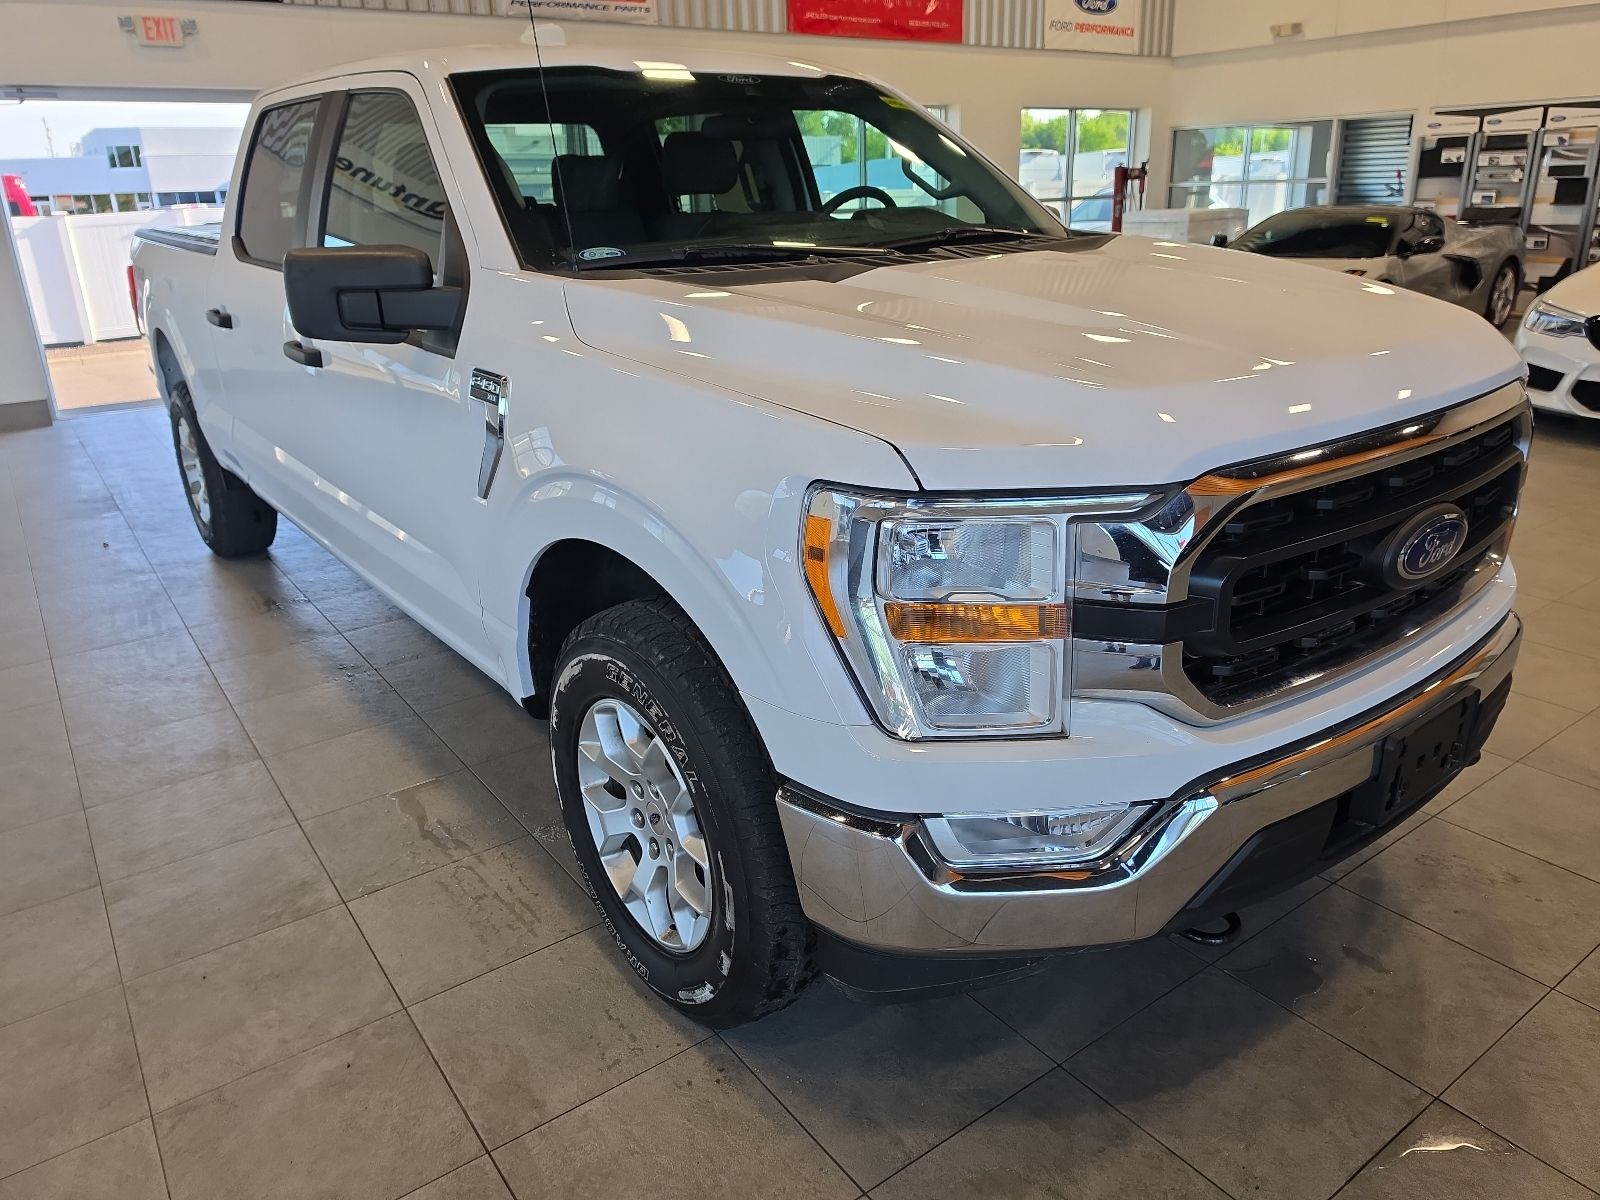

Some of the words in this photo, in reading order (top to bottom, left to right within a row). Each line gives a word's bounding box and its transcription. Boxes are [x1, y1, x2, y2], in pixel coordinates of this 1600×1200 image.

[510, 0, 610, 12] PERFORMANCE
[614, 5, 651, 14] PARTS
[142, 16, 176, 42] EXIT
[1049, 20, 1073, 32] FORD
[1074, 22, 1135, 37] PERFORMANCE
[1418, 527, 1458, 569] Ford
[605, 662, 698, 794] GENERAL
